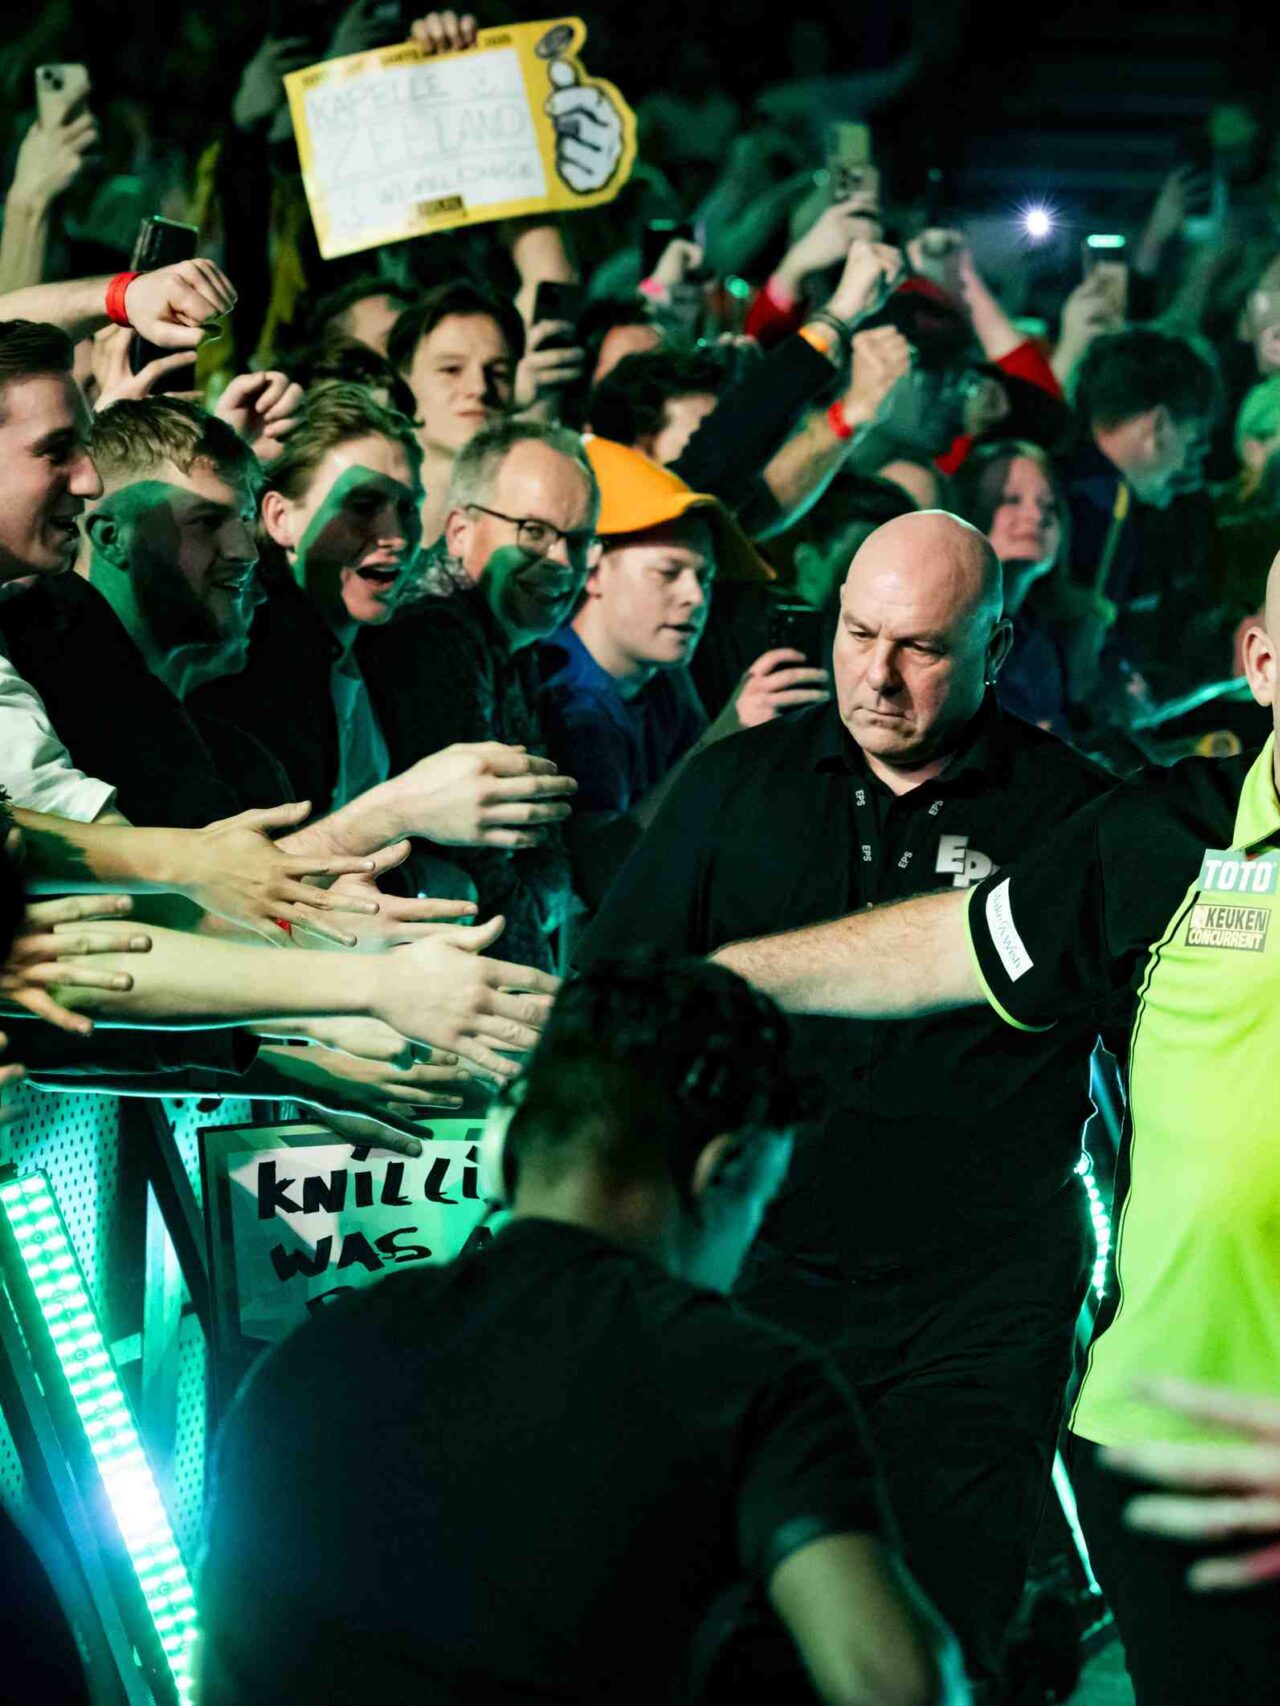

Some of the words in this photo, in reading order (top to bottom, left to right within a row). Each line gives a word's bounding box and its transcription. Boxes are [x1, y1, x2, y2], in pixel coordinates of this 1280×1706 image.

[855, 789, 866, 806] EPS
[928, 799, 944, 816] EPS
[861, 844, 872, 862] EPS
[897, 851, 914, 869] EPS
[935, 834, 1000, 887] EP
[1203, 860, 1273, 892] TOTO
[1205, 907, 1267, 931] KEUKEN
[1188, 928, 1263, 950] CONCURRENT
[270, 1226, 432, 1283] WAS
